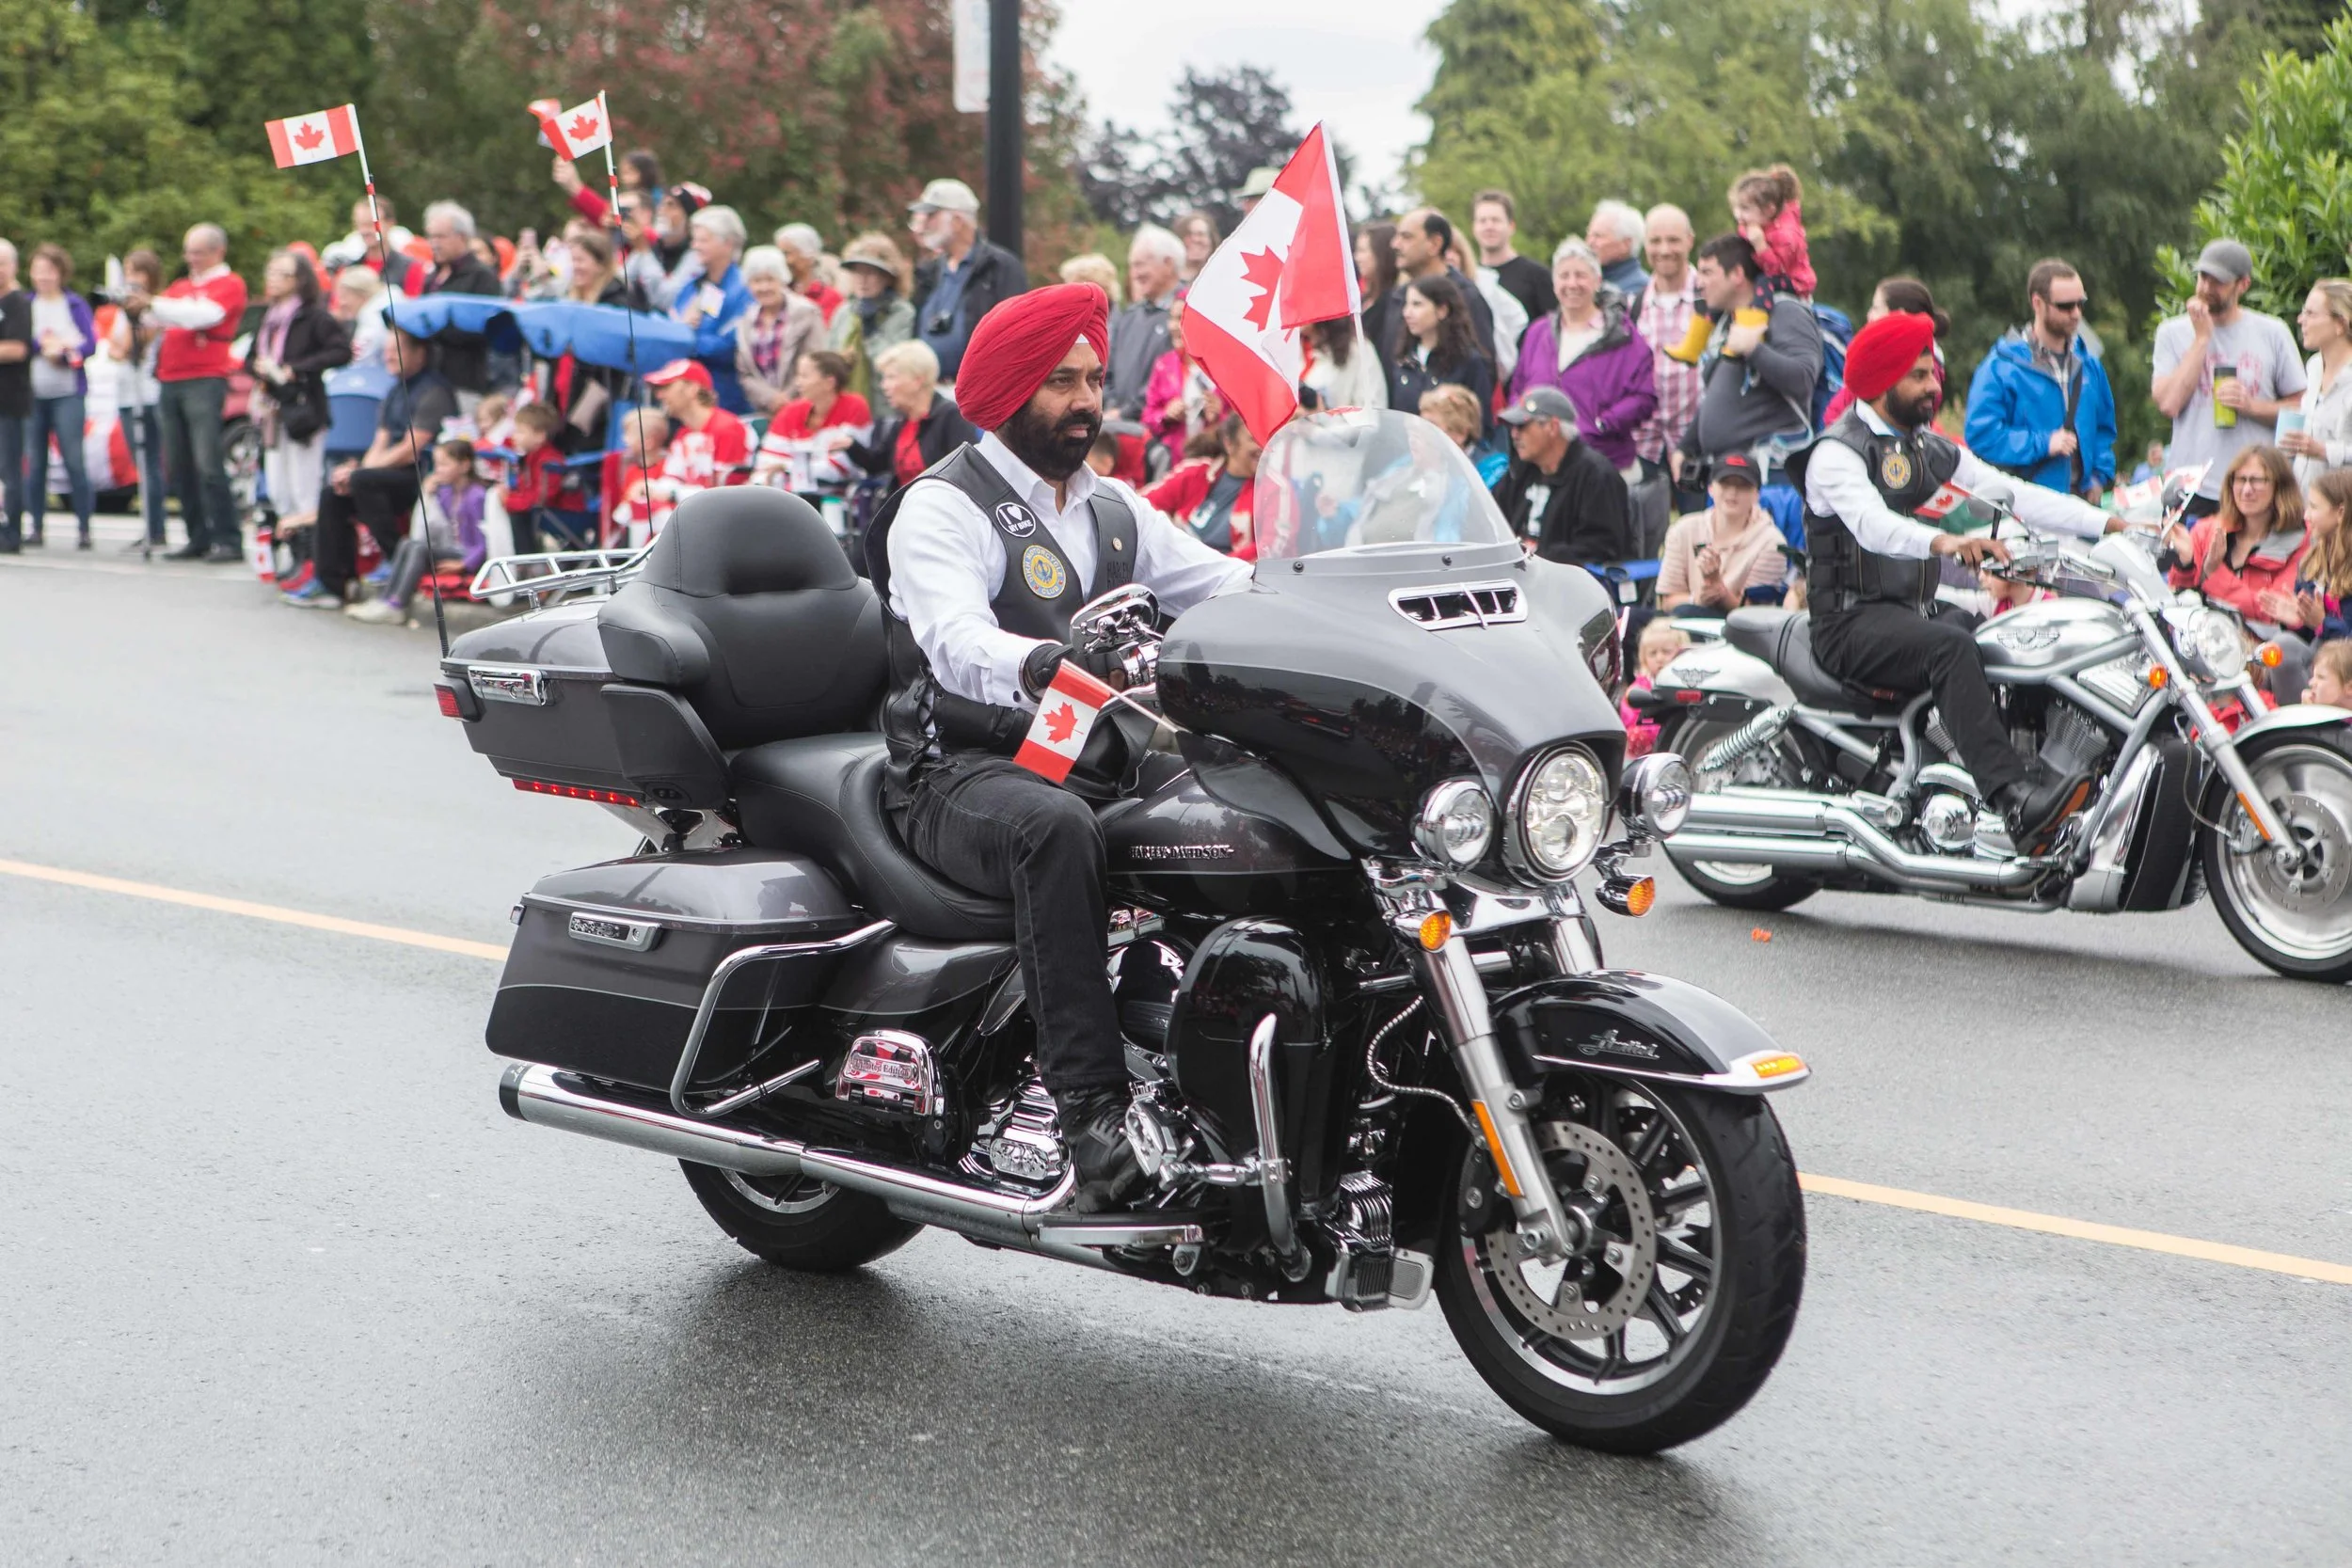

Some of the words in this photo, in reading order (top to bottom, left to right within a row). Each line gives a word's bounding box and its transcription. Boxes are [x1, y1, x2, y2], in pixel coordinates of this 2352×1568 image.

[998, 509, 1011, 525] I
[1008, 523, 1019, 533] MY
[1017, 519, 1033, 530] BIKE
[1041, 585, 1060, 595] CLUB
[852, 1057, 882, 1072] Limited
[883, 1064, 910, 1077] Edition
